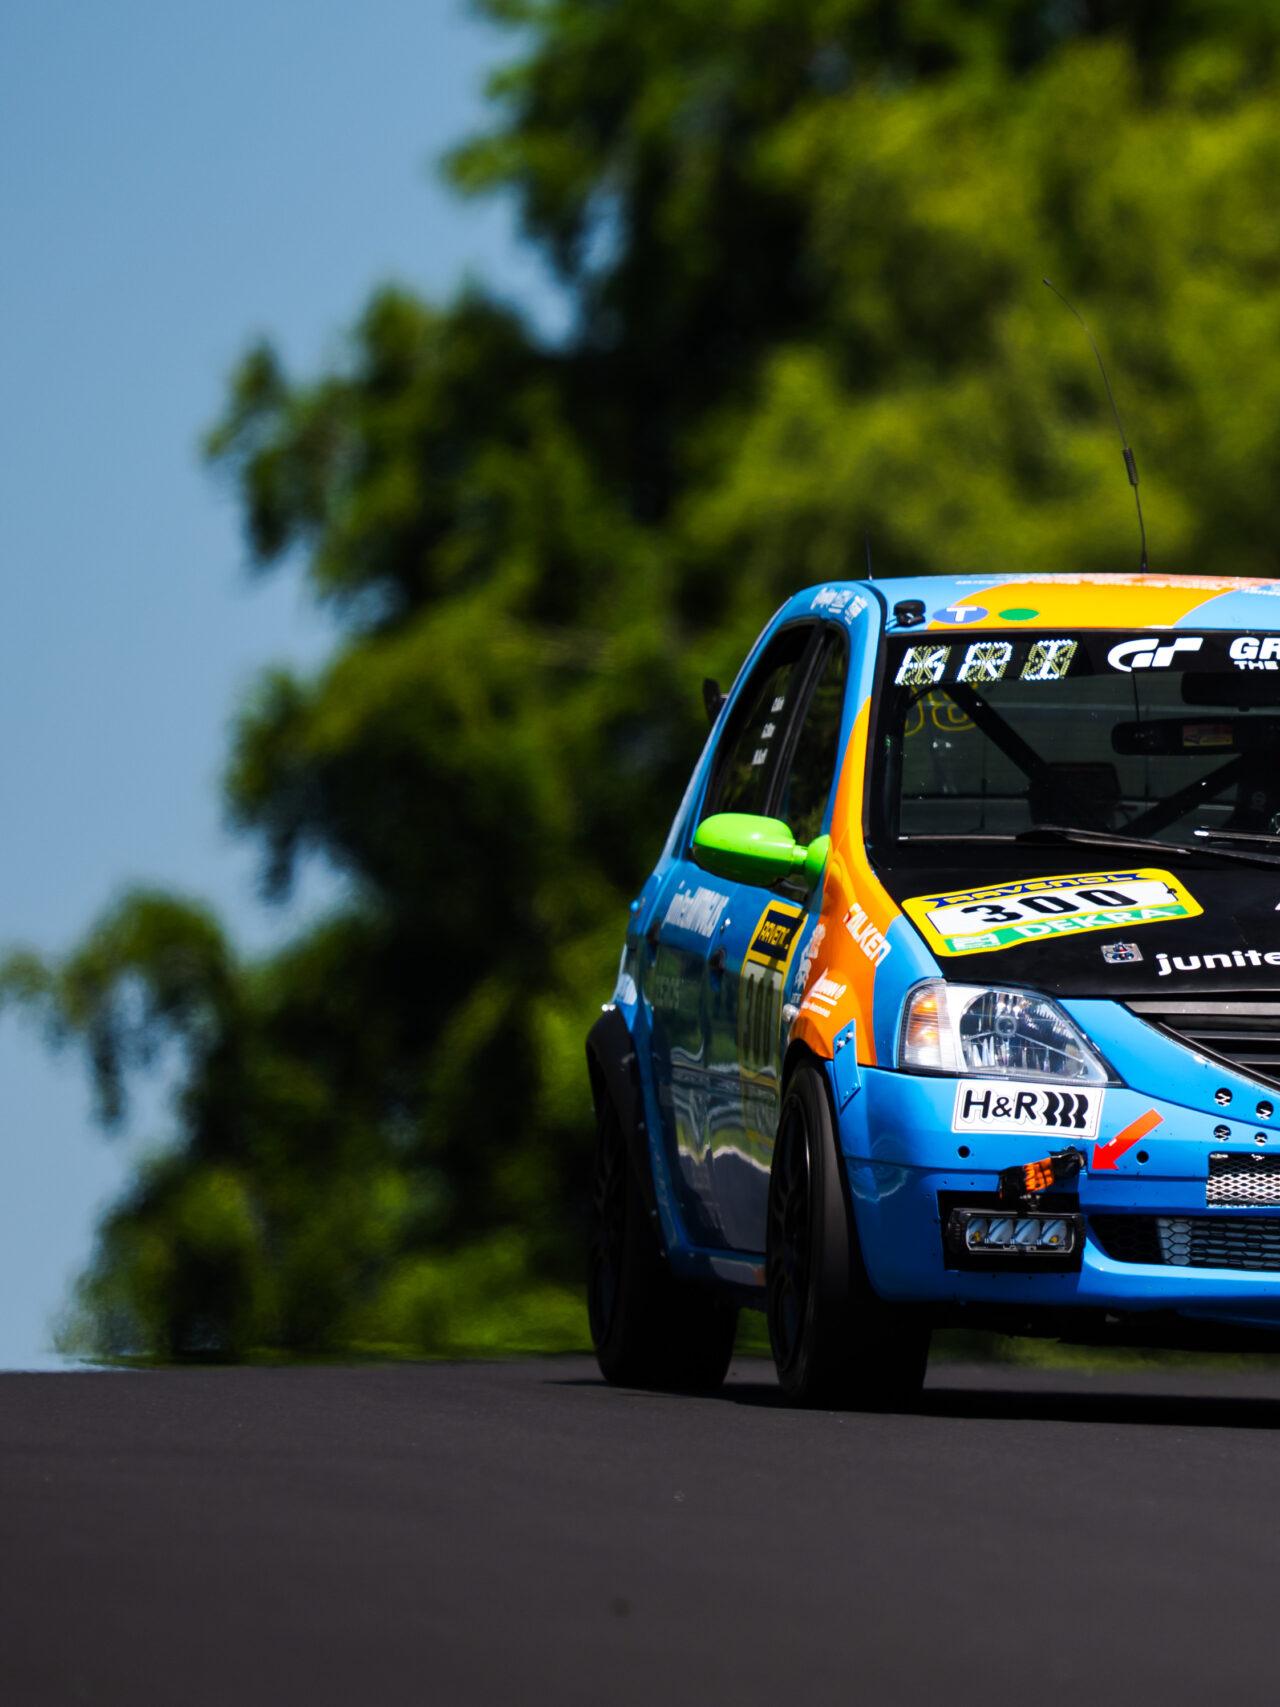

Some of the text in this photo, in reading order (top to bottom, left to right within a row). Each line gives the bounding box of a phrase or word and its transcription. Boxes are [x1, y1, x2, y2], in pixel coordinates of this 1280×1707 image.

[1234, 660, 1279, 671] THE
[940, 873, 1134, 904] RAVENOL
[961, 889, 1139, 923] 300
[843, 902, 892, 967] FALKEN
[1015, 908, 1169, 938] DEKRA
[963, 1089, 1038, 1120] H&R
